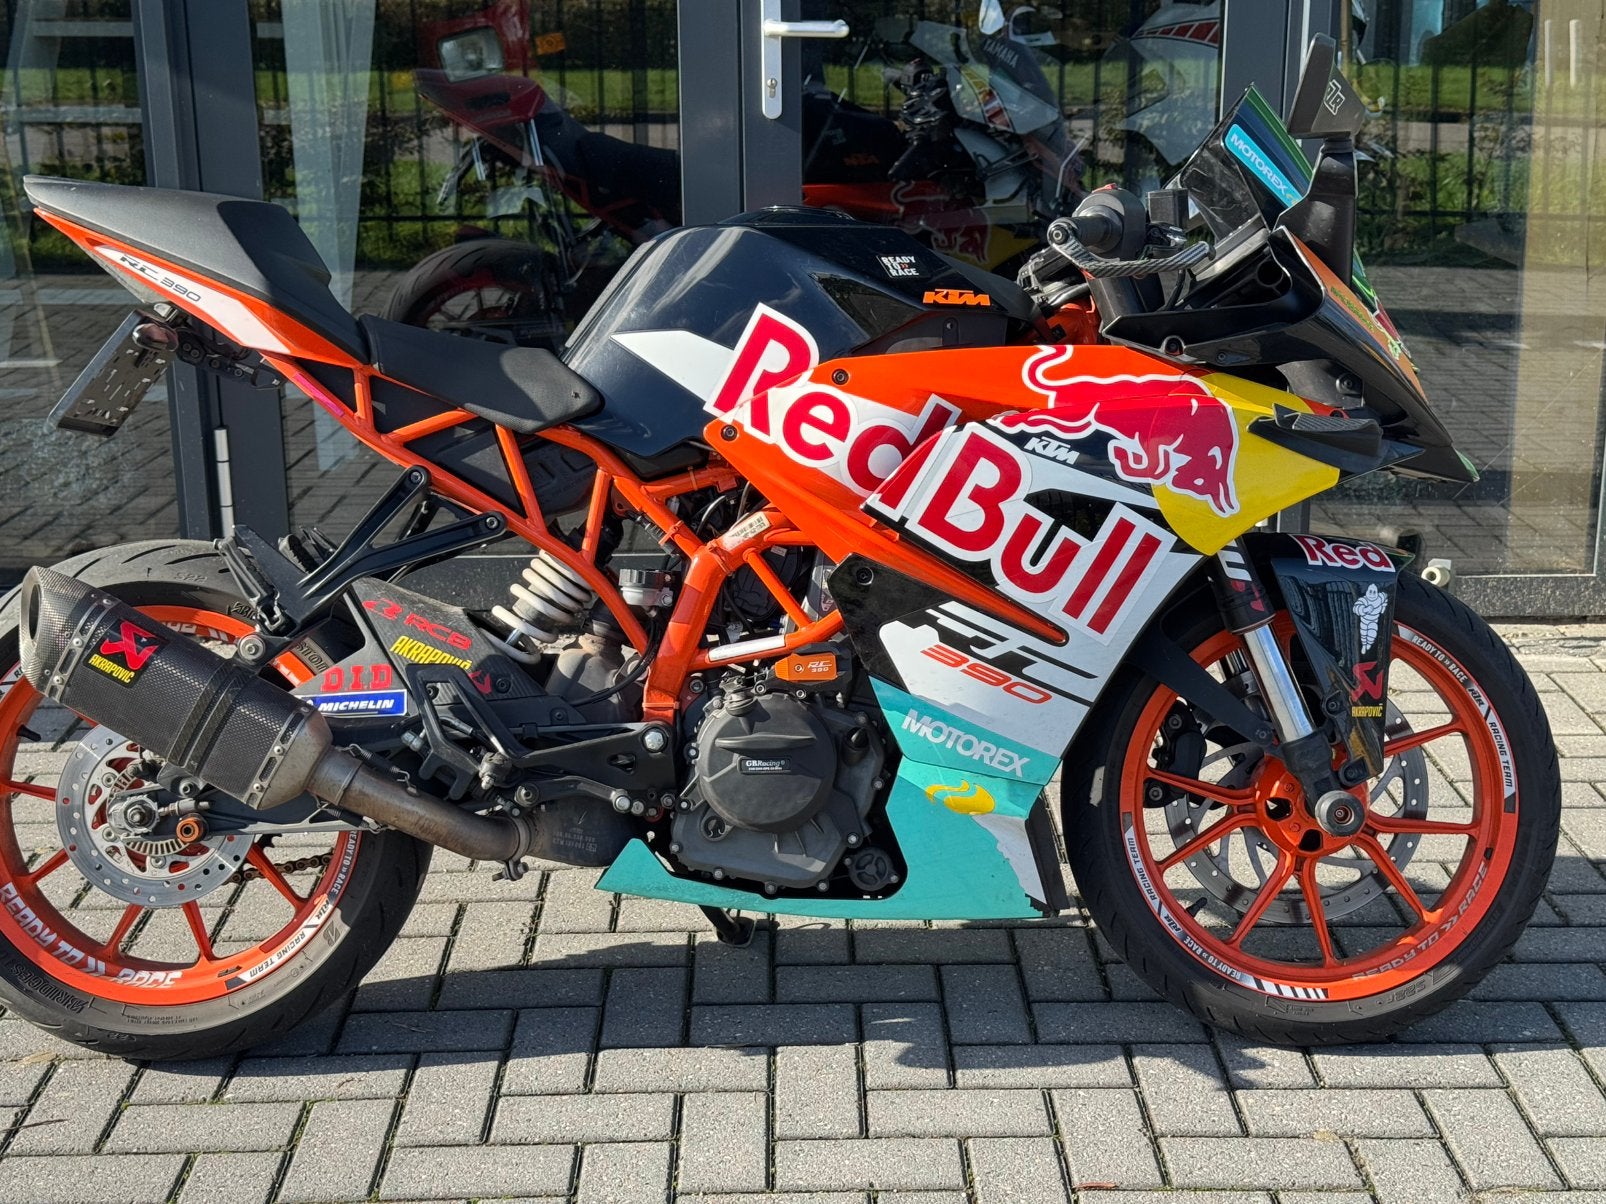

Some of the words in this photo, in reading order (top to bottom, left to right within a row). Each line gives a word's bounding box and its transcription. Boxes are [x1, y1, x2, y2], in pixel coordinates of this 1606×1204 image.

[1231, 133, 1288, 195] MOTOREX
[880, 256, 916, 265] READY
[889, 268, 919, 277] RACE
[120, 256, 158, 281] RC
[161, 277, 202, 302] 390
[923, 288, 991, 306] KTM
[1024, 436, 1080, 465] KTM
[707, 306, 958, 516] Red
[911, 426, 1168, 641] Bull
[1293, 535, 1395, 572] Red
[404, 612, 473, 650] RCB
[920, 644, 1053, 704] 390
[317, 699, 395, 712] MICHELIN
[1412, 635, 1437, 653] READY
[1434, 651, 1445, 661] TO
[1448, 664, 1468, 683] RACE
[1489, 721, 1507, 756] RACING
[1502, 761, 1513, 788] TEAM
[901, 708, 1030, 778] MOTOREX
[344, 856, 353, 867] TO
[1127, 837, 1141, 864] TEAM
[331, 872, 346, 895] RACE
[1137, 868, 1157, 900] RACING
[1, 882, 57, 947] READY
[51, 940, 85, 965] TO
[110, 968, 183, 988] RACE
[1352, 948, 1417, 981] READY
[1417, 931, 1440, 951] TO
[1458, 861, 1488, 915] RACE
[277, 931, 306, 960] RACING
[1184, 936, 1203, 955] RACE
[249, 955, 275, 978] TEAM
[1207, 955, 1221, 967] TO
[1217, 961, 1242, 979] READY
